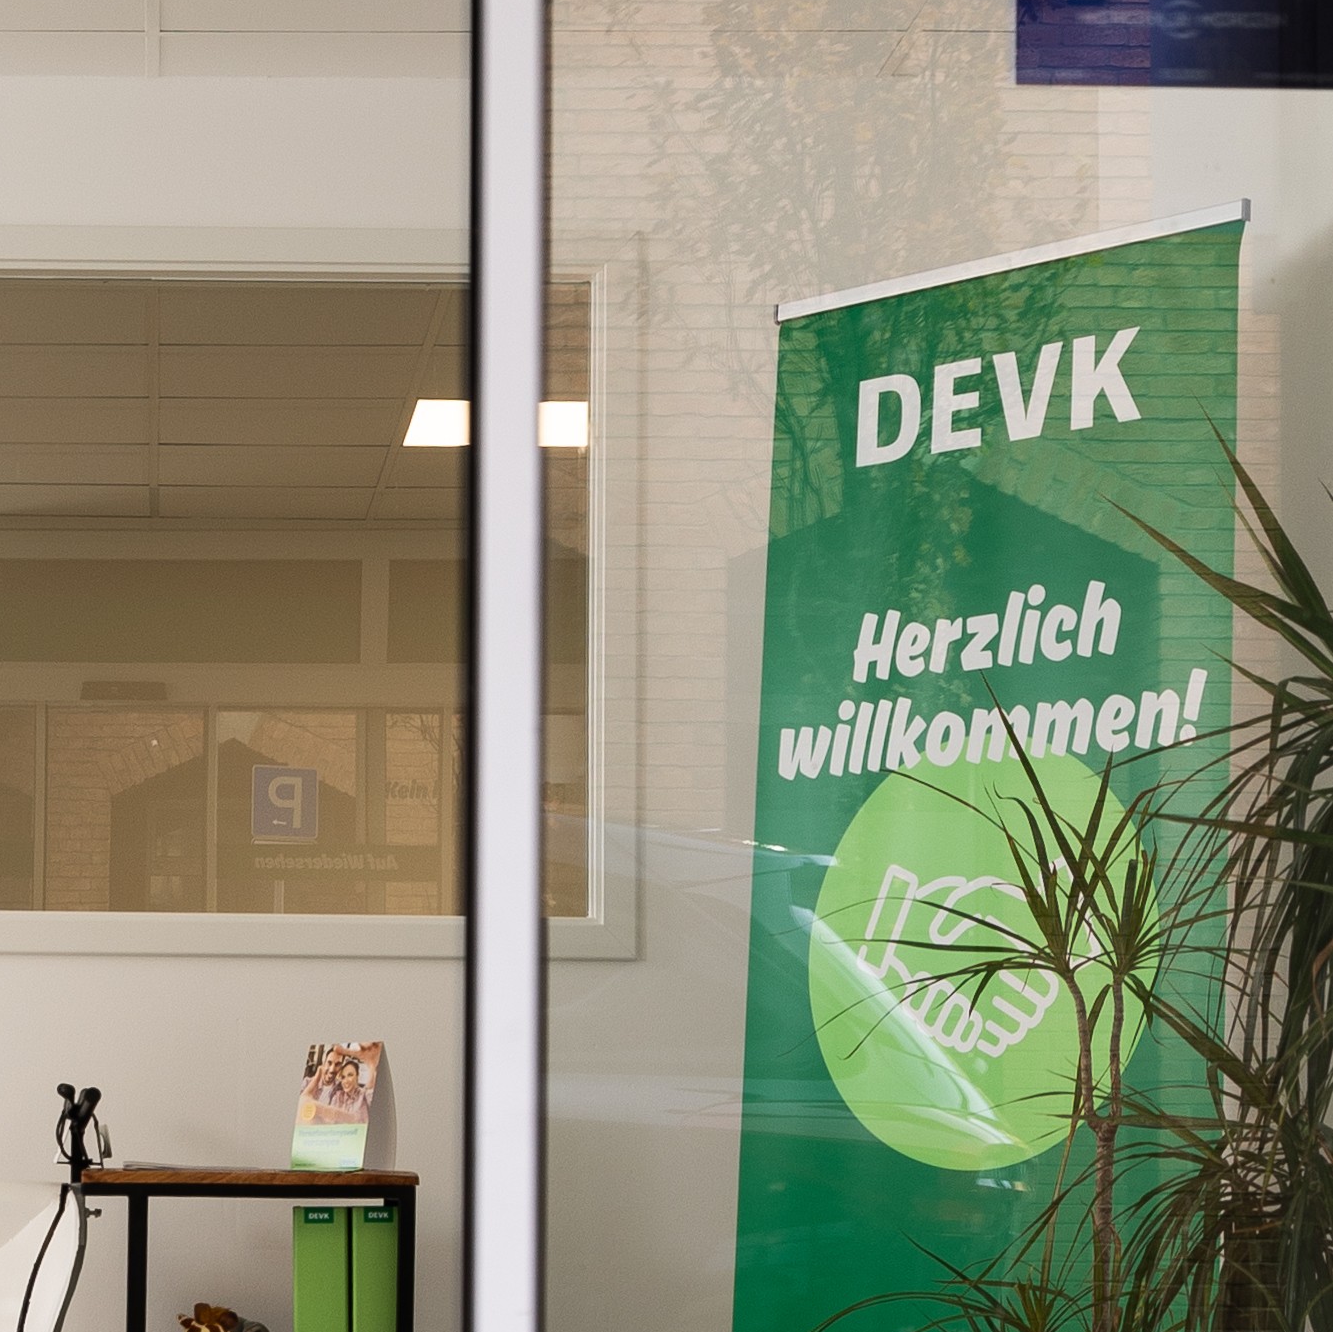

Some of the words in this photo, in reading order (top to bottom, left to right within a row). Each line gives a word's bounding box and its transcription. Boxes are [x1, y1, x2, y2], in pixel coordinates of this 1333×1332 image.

[856, 326, 1142, 469] DEVK
[852, 579, 1122, 684] Herzlich
[778, 667, 1209, 781] willkommen!
[308, 1211, 330, 1220] DEVK
[368, 1211, 389, 1219] DEVK
